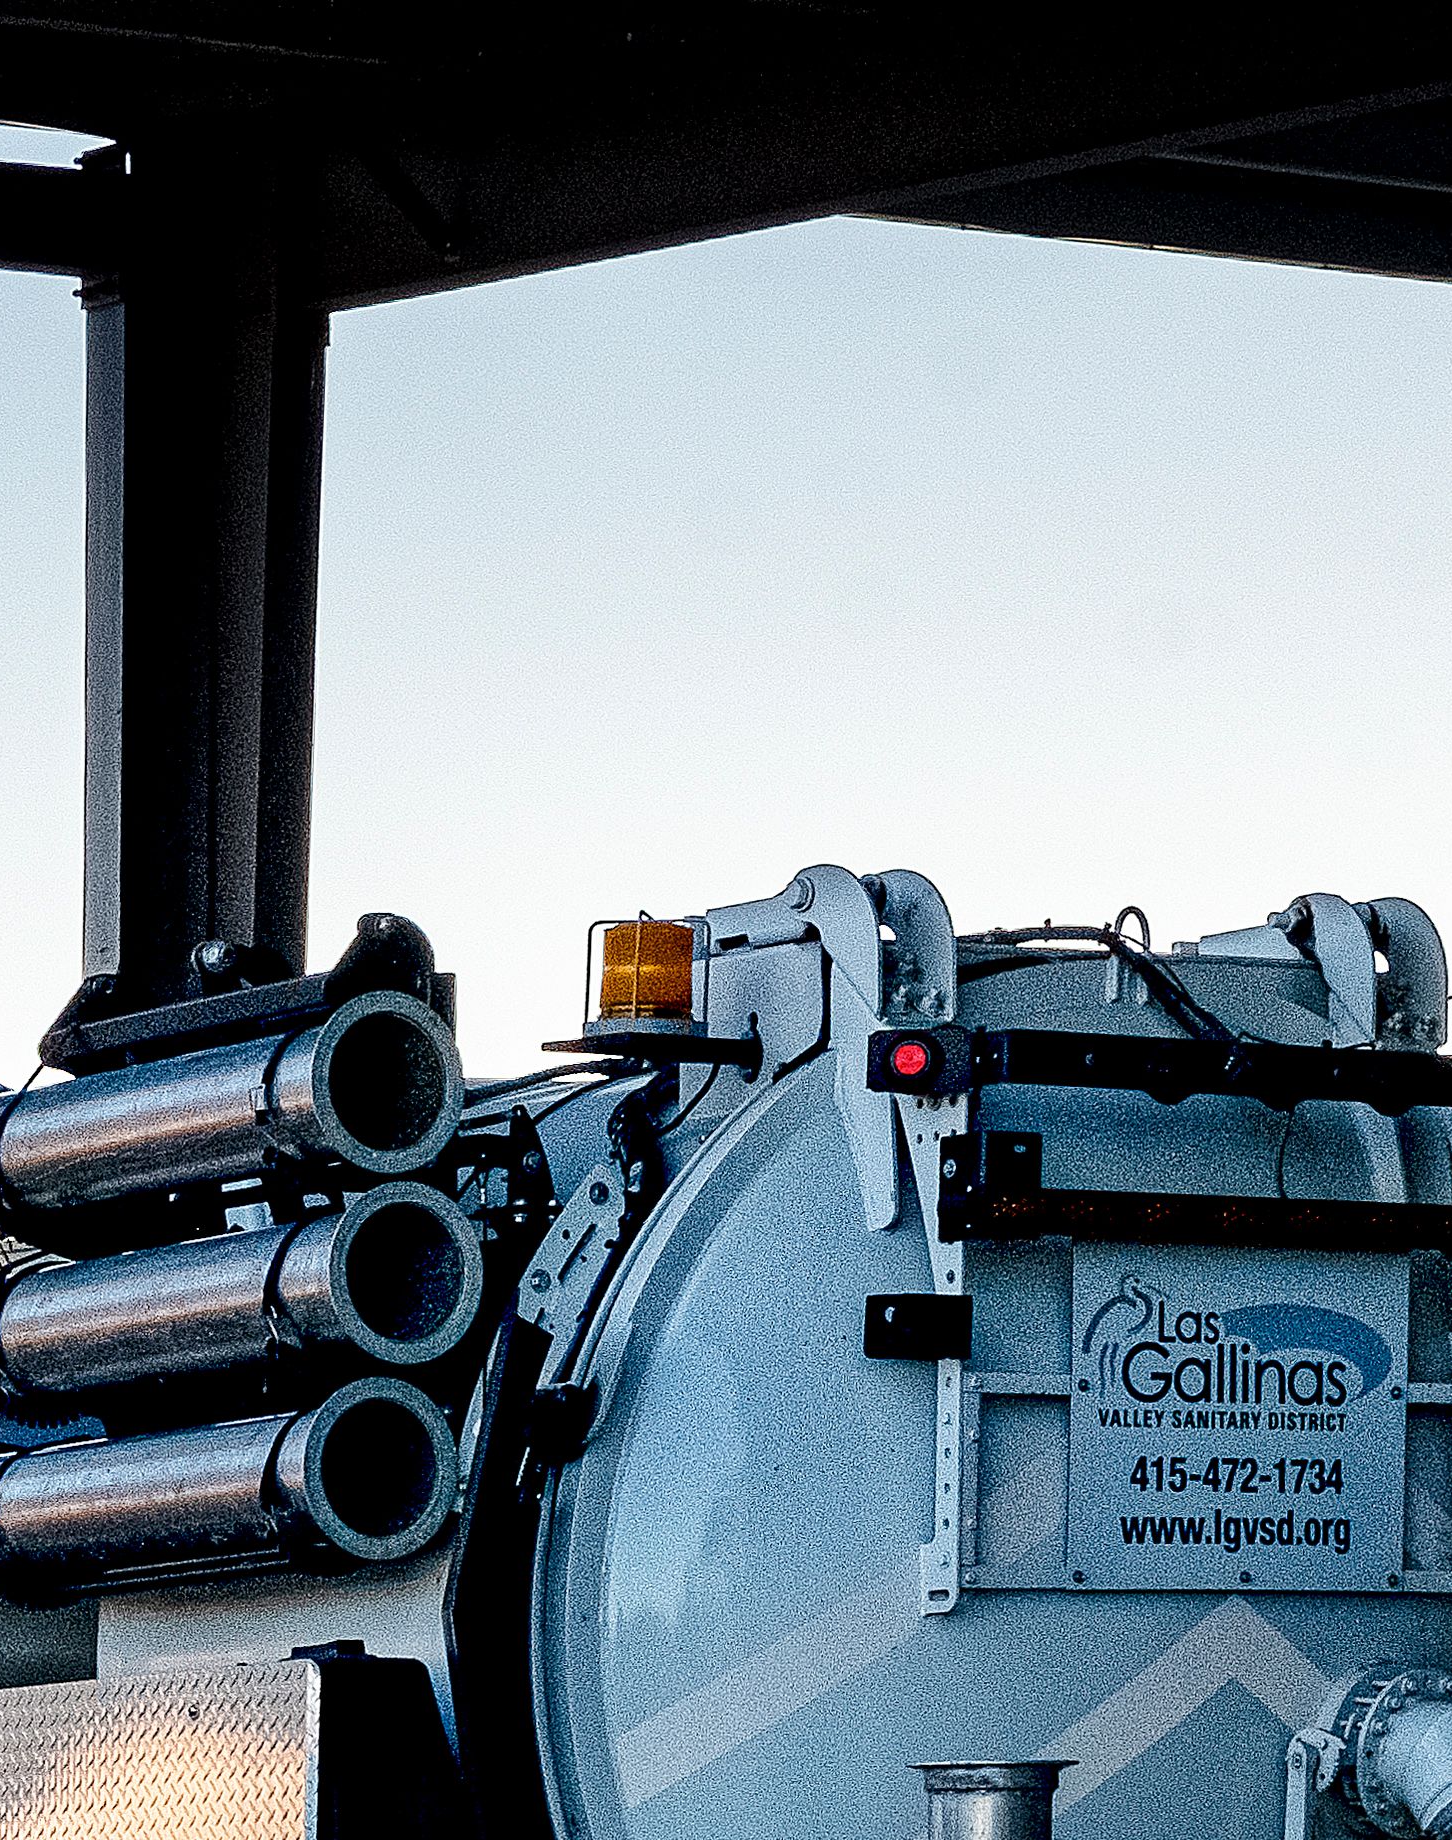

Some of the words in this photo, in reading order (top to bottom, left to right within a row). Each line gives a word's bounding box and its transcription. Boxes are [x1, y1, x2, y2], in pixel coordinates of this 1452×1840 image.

[1158, 1299, 1221, 1344] Las
[1122, 1341, 1347, 1407] Gallinas
[1098, 1408, 1165, 1429] VALLEY
[1171, 1410, 1262, 1430] SANITARY
[1268, 1411, 1347, 1433] DISTRICT
[1130, 1456, 1344, 1495] 415-472-1734
[1120, 1508, 1351, 1554] www.lgvsd.org
